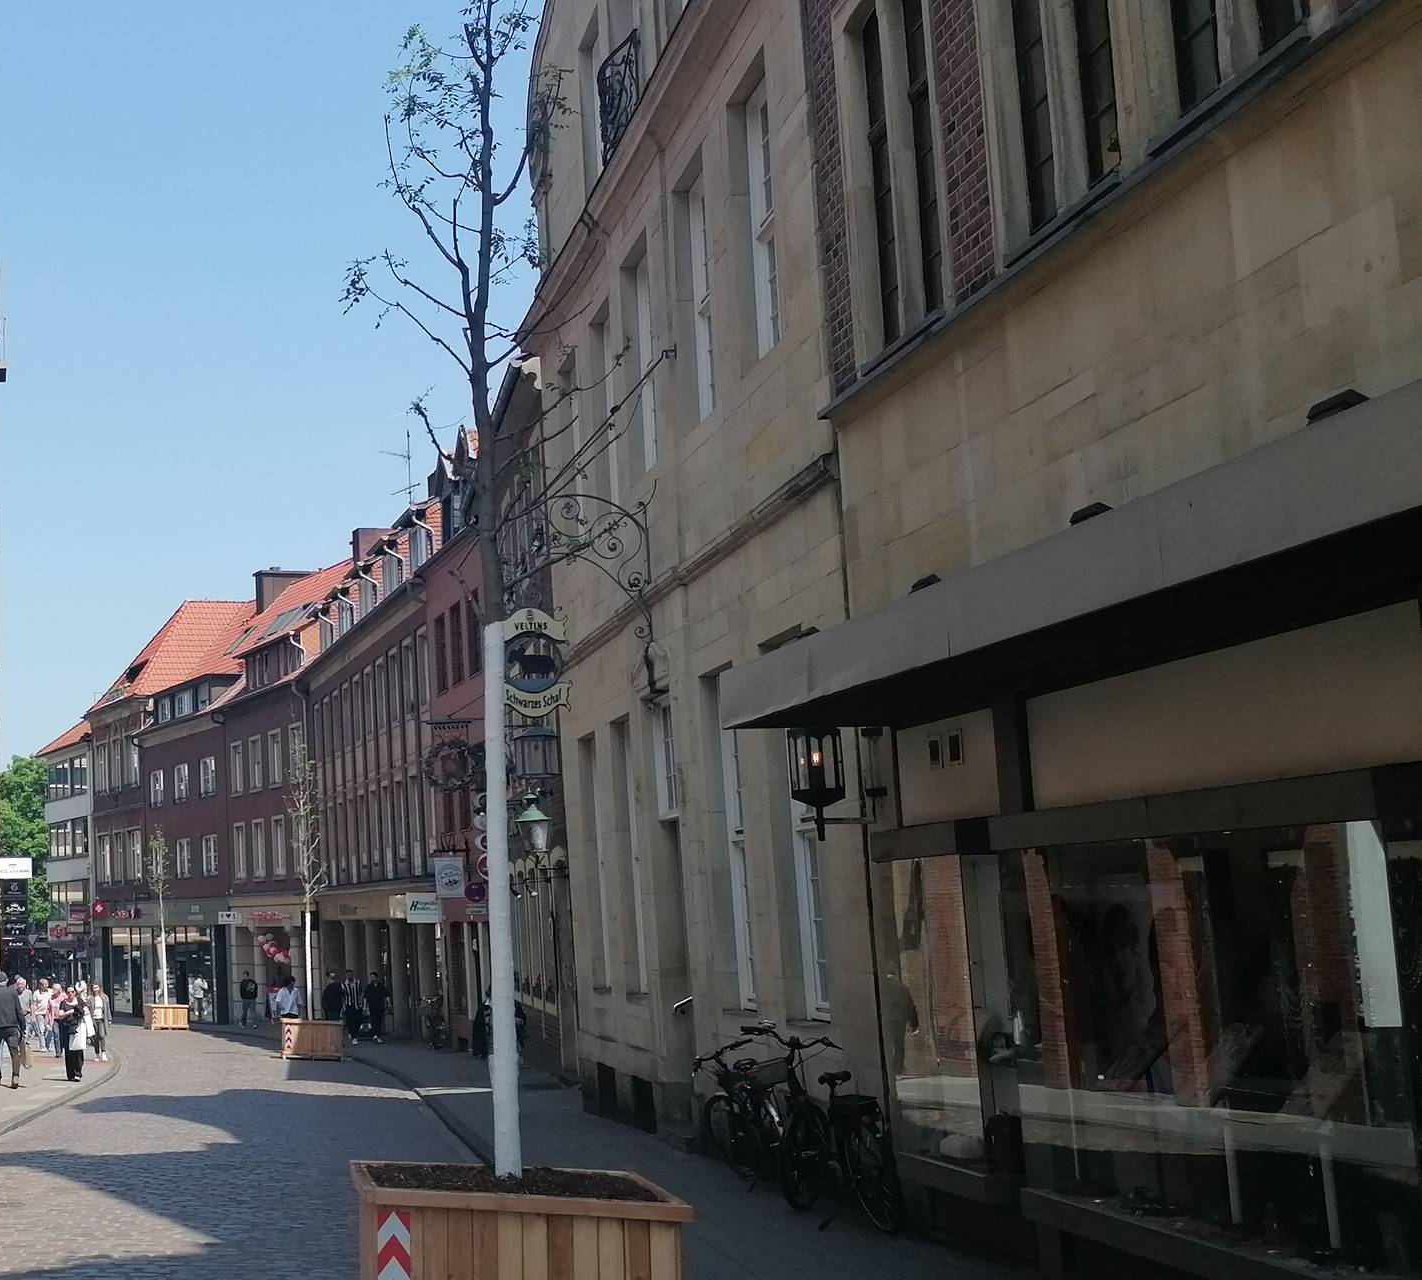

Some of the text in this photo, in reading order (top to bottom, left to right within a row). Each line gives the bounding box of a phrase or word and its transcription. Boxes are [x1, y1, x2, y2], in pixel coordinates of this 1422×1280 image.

[514, 621, 548, 631] VELTINS
[506, 688, 562, 709] Schwarzes Schaf
